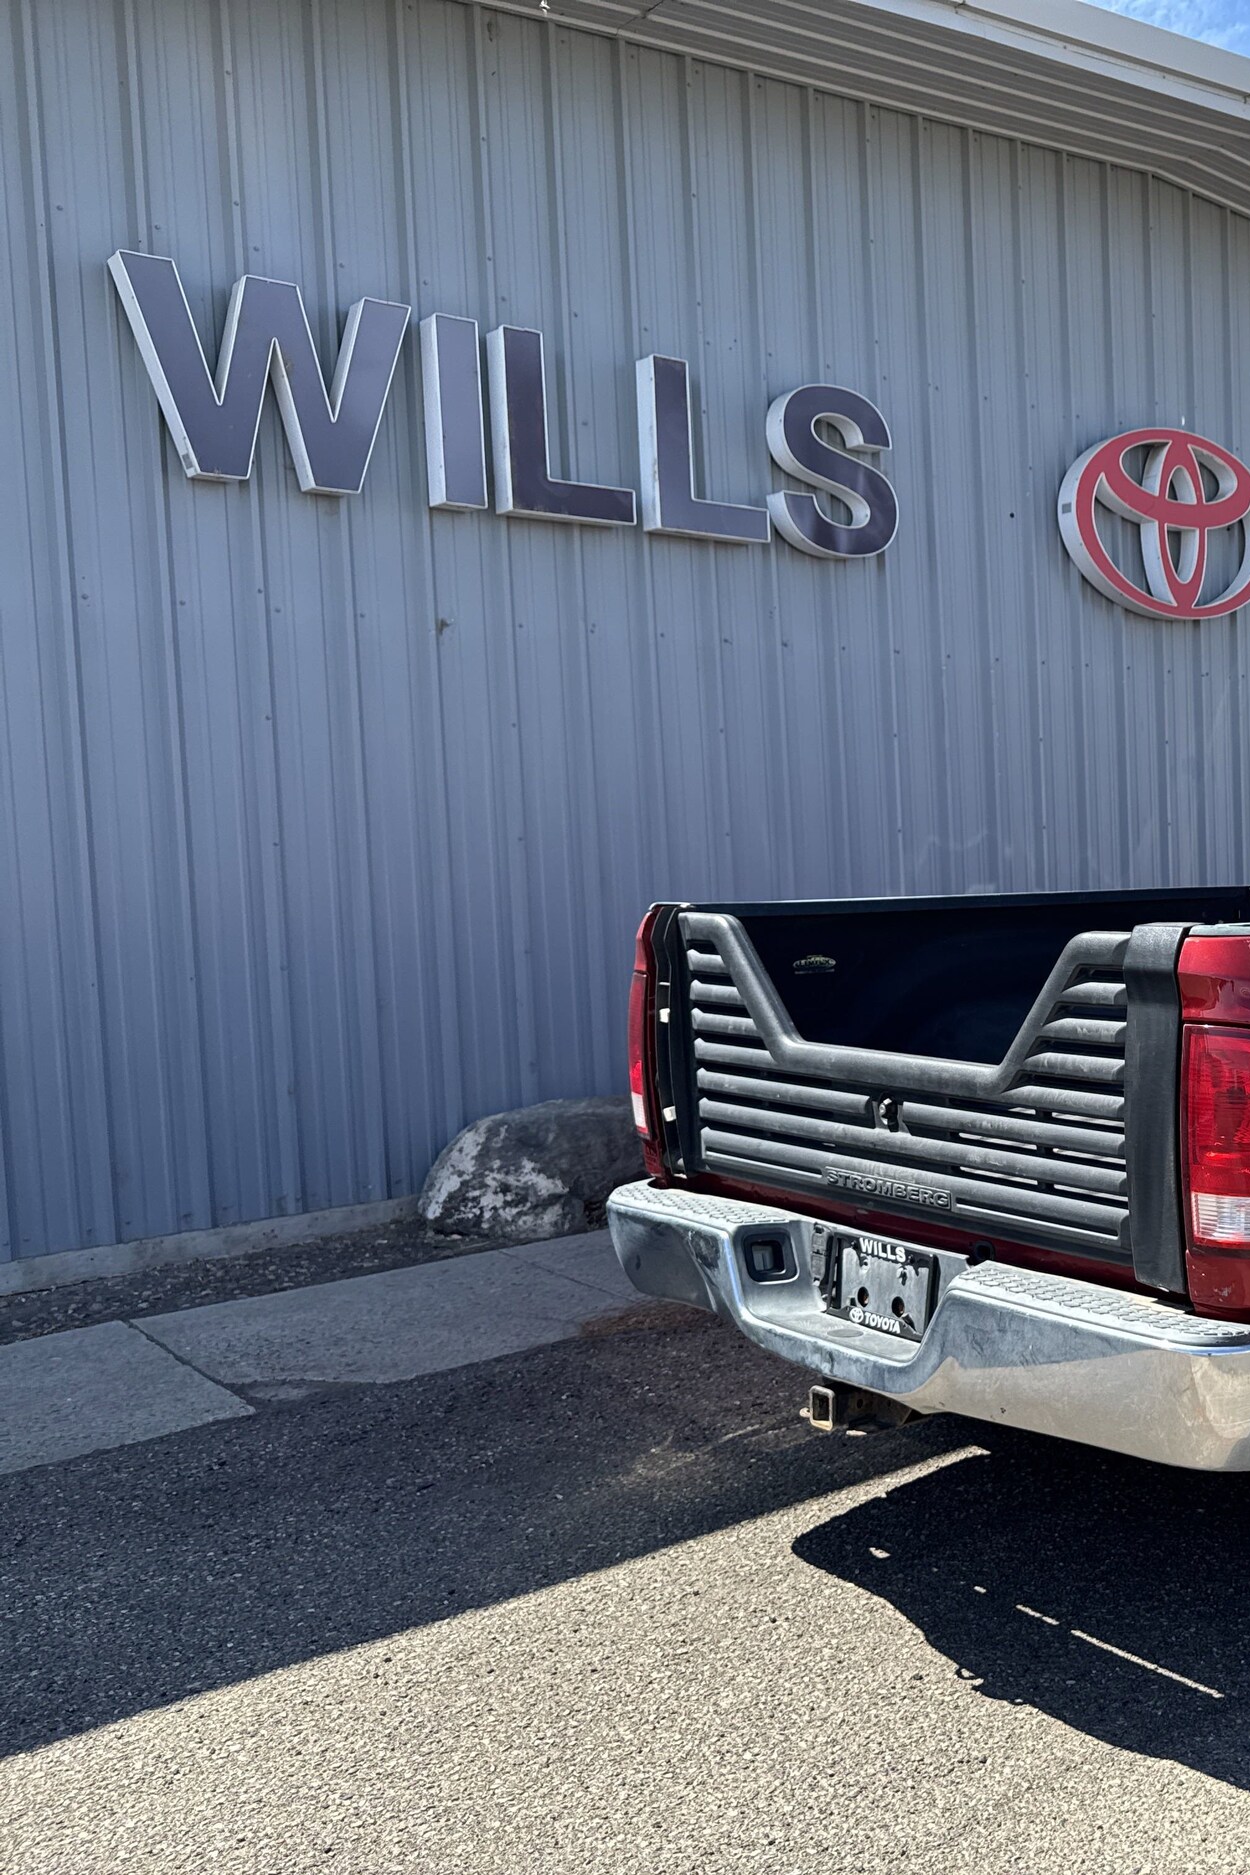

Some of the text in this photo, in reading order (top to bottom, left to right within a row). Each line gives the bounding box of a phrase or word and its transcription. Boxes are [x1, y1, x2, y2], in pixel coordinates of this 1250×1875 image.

[108, 249, 899, 559] WILLS
[826, 1169, 950, 1208] STROMBERG
[859, 1237, 906, 1262] WILLS
[865, 1312, 900, 1333] TOYOTA
